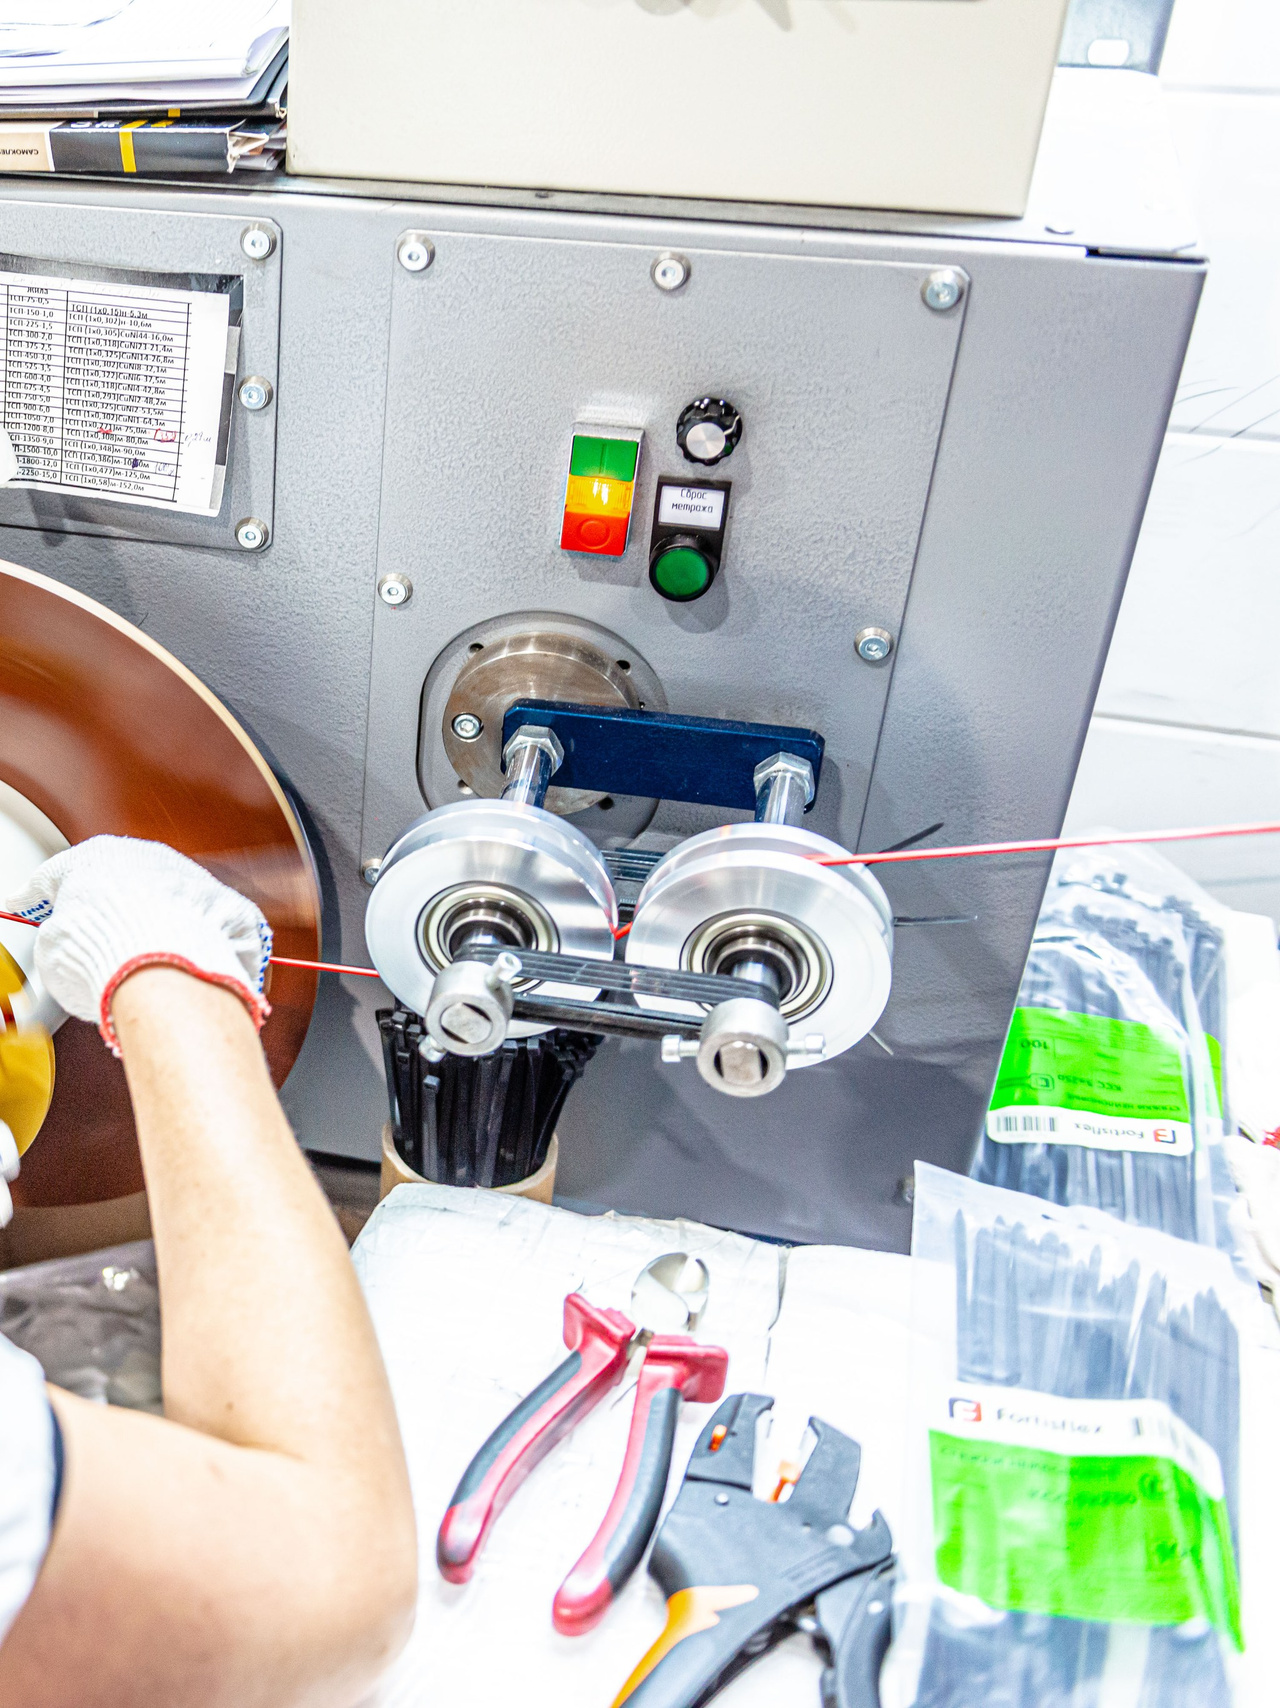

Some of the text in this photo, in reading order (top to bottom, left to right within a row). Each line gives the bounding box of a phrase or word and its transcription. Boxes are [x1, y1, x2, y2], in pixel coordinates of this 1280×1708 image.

[9, 306, 53, 318] ТСП-150-1,0
[72, 304, 87, 312] ТСП
[68, 313, 83, 321] ТСП
[9, 318, 52, 330] ТСП-225-1,5
[8, 328, 52, 341] ТСП-300-2,0
[67, 335, 81, 343] ТСП
[8, 339, 52, 351] ТСП-375-2,5
[68, 346, 83, 354] ТСП
[8, 350, 51, 361] ТСП-450-3,0
[66, 356, 81, 364] ТСП
[7, 359, 51, 372] ТСП-525-3,5
[66, 366, 80, 375] ТСП
[7, 370, 51, 383] ТСП-600-4,0
[65, 377, 80, 385] ТСП
[7, 380, 50, 393] ТСП-675-4,5
[67, 387, 81, 396] ТСП
[7, 391, 50, 403] ТСП-750-5,0
[65, 398, 79, 406] ТСП
[6, 400, 50, 413] ТСП-900-6,0
[66, 408, 81, 416] ТСП
[7, 411, 54, 424] ТСП-1050-7,0
[6, 420, 54, 434] ТСП-1200-8,0
[65, 428, 80, 436] ТСП
[8, 432, 53, 445] СП-1350-9,0
[64, 449, 77, 458] ТСП
[65, 462, 79, 470] ТСП
[64, 473, 78, 482] ТСП
[680, 488, 708, 501] Сброс
[671, 501, 714, 514] метража
[1073, 1122, 1145, 1140] Fortisflex
[996, 1406, 1104, 1435] Fortisflex
